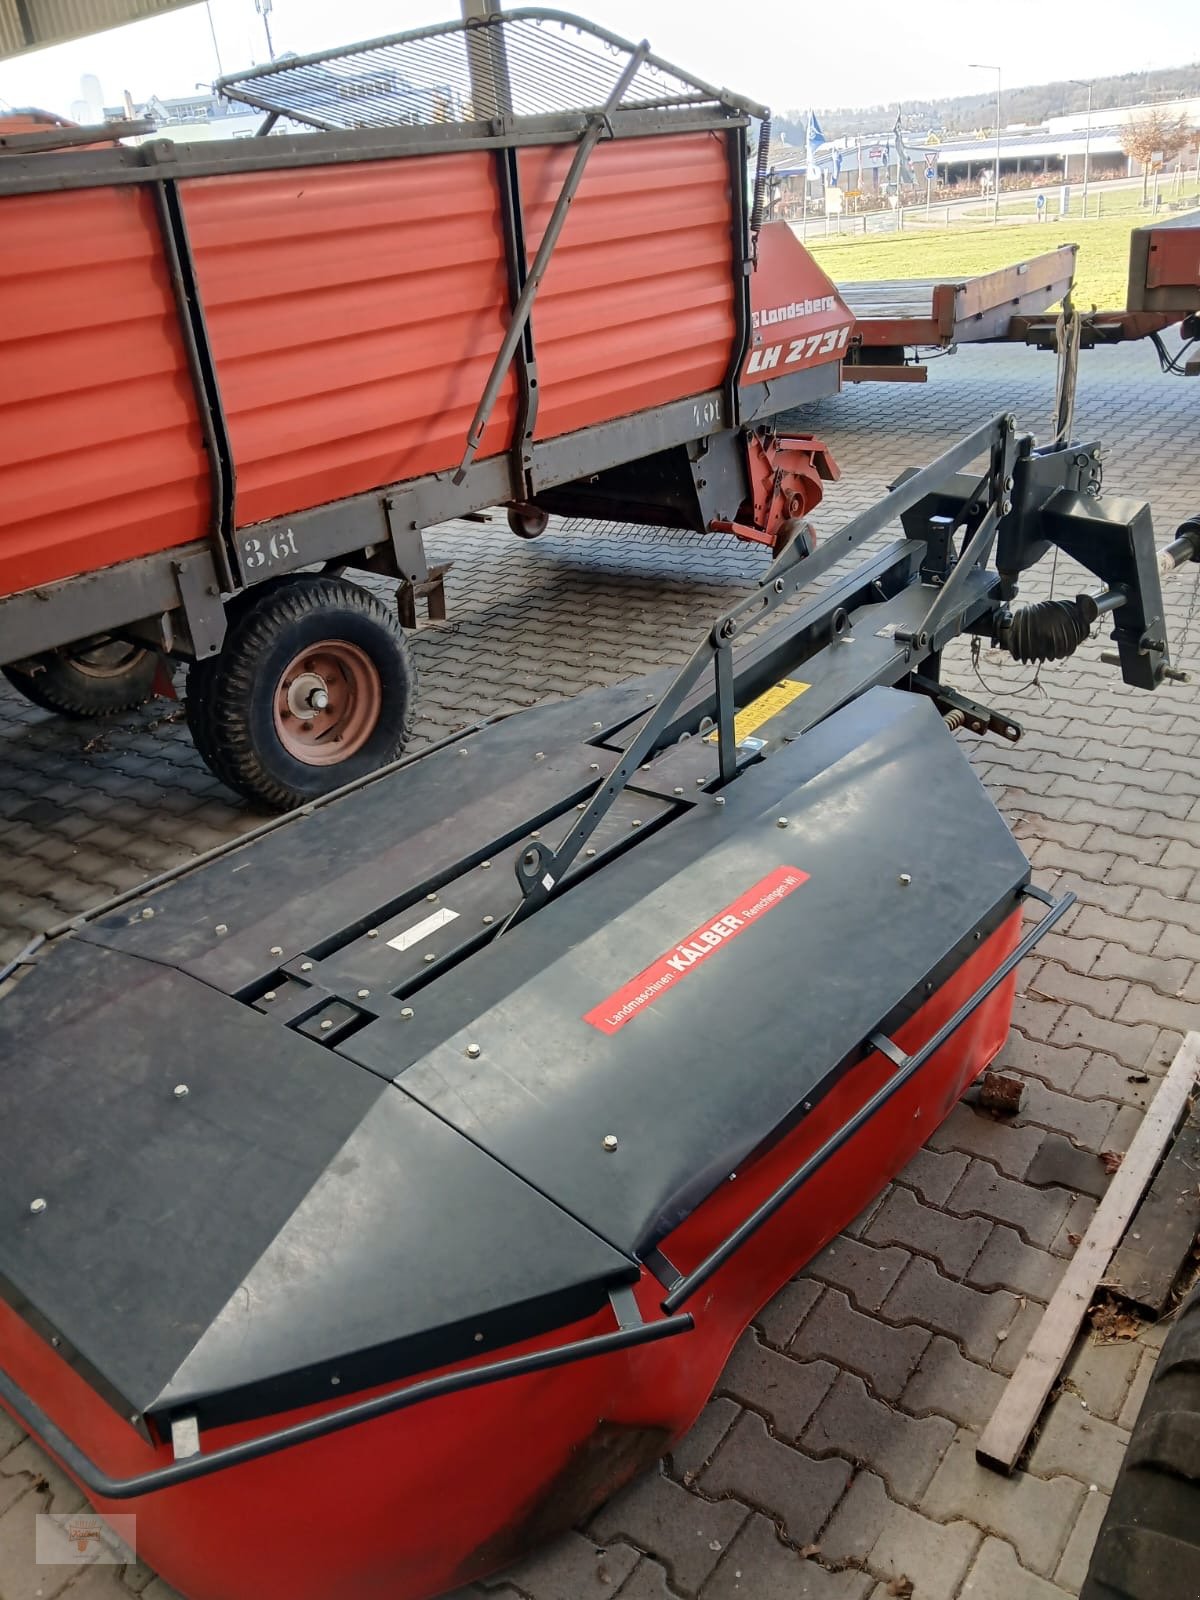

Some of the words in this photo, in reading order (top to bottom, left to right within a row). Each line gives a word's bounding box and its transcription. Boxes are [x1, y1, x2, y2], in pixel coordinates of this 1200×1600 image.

[760, 296, 835, 327] Landsberg
[746, 345, 782, 374] LH
[785, 326, 850, 363] 2731
[604, 973, 675, 1026] Landmaschinen
[666, 914, 745, 972] KÄLBER
